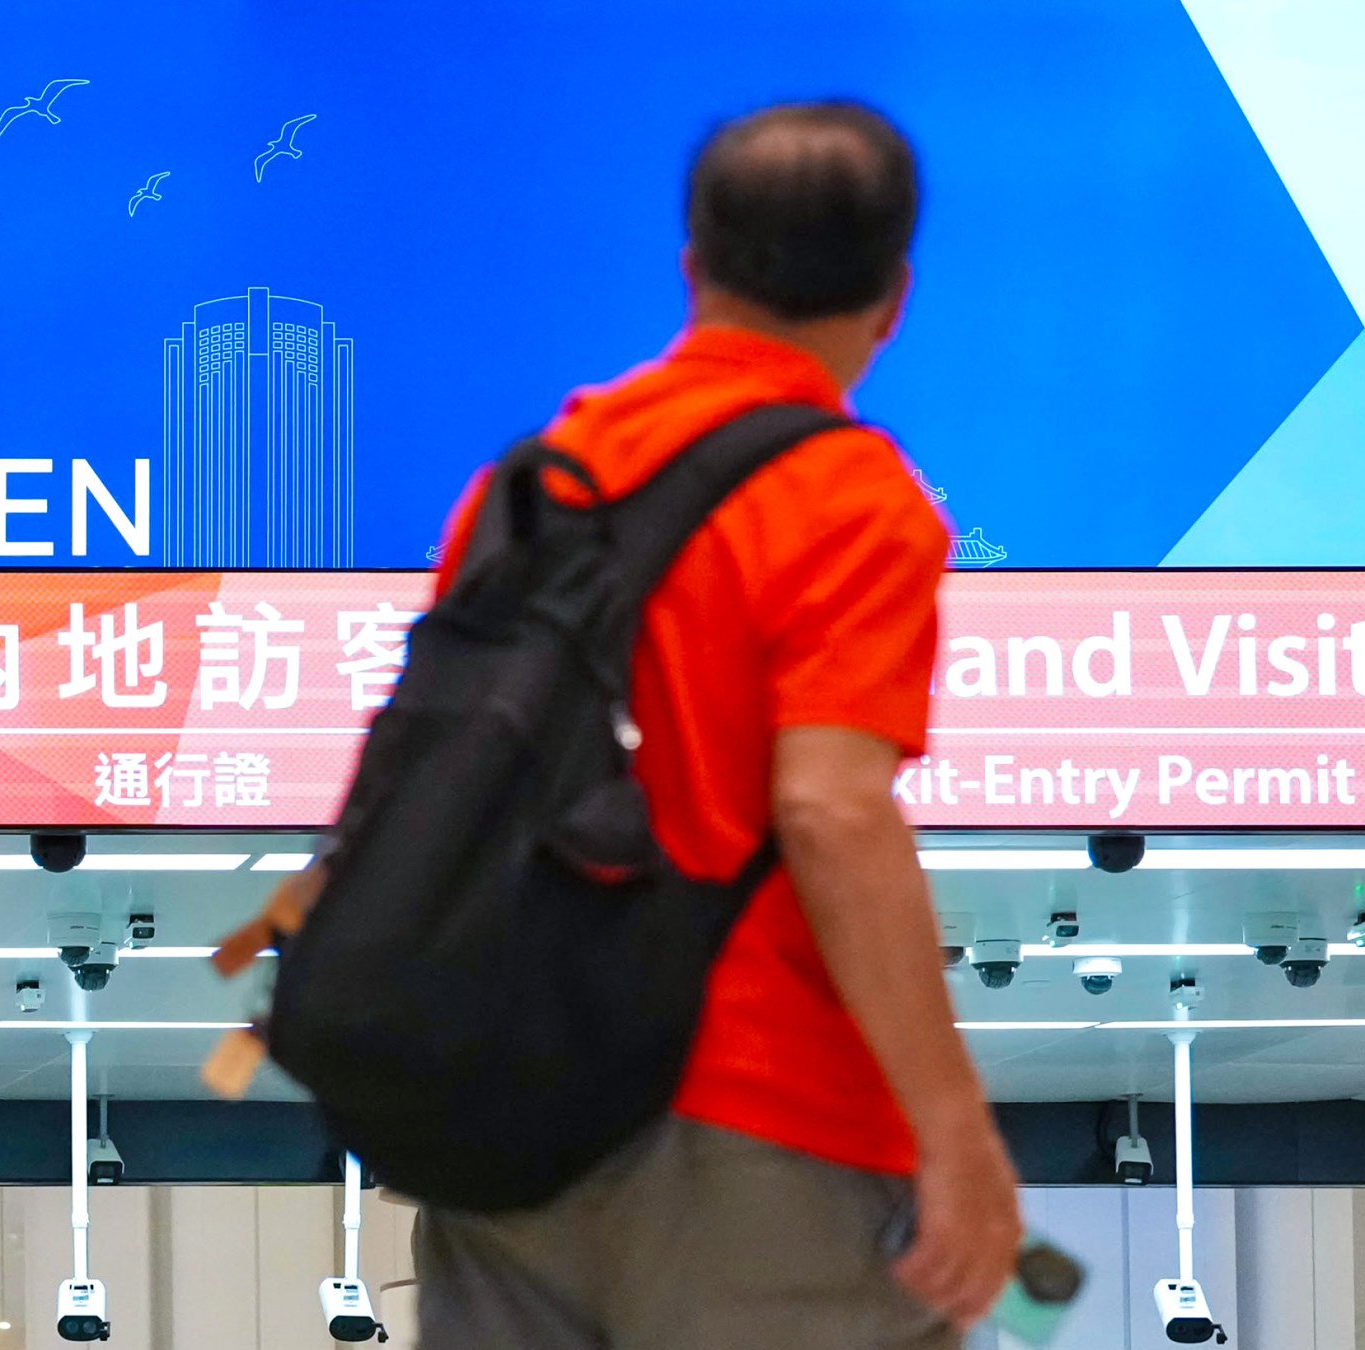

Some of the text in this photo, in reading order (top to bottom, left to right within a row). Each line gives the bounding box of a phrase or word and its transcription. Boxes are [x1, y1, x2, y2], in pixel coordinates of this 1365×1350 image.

[929, 610, 1132, 697] and
[94, 751, 272, 808] 通行證
[1158, 754, 1355, 805] Permit
